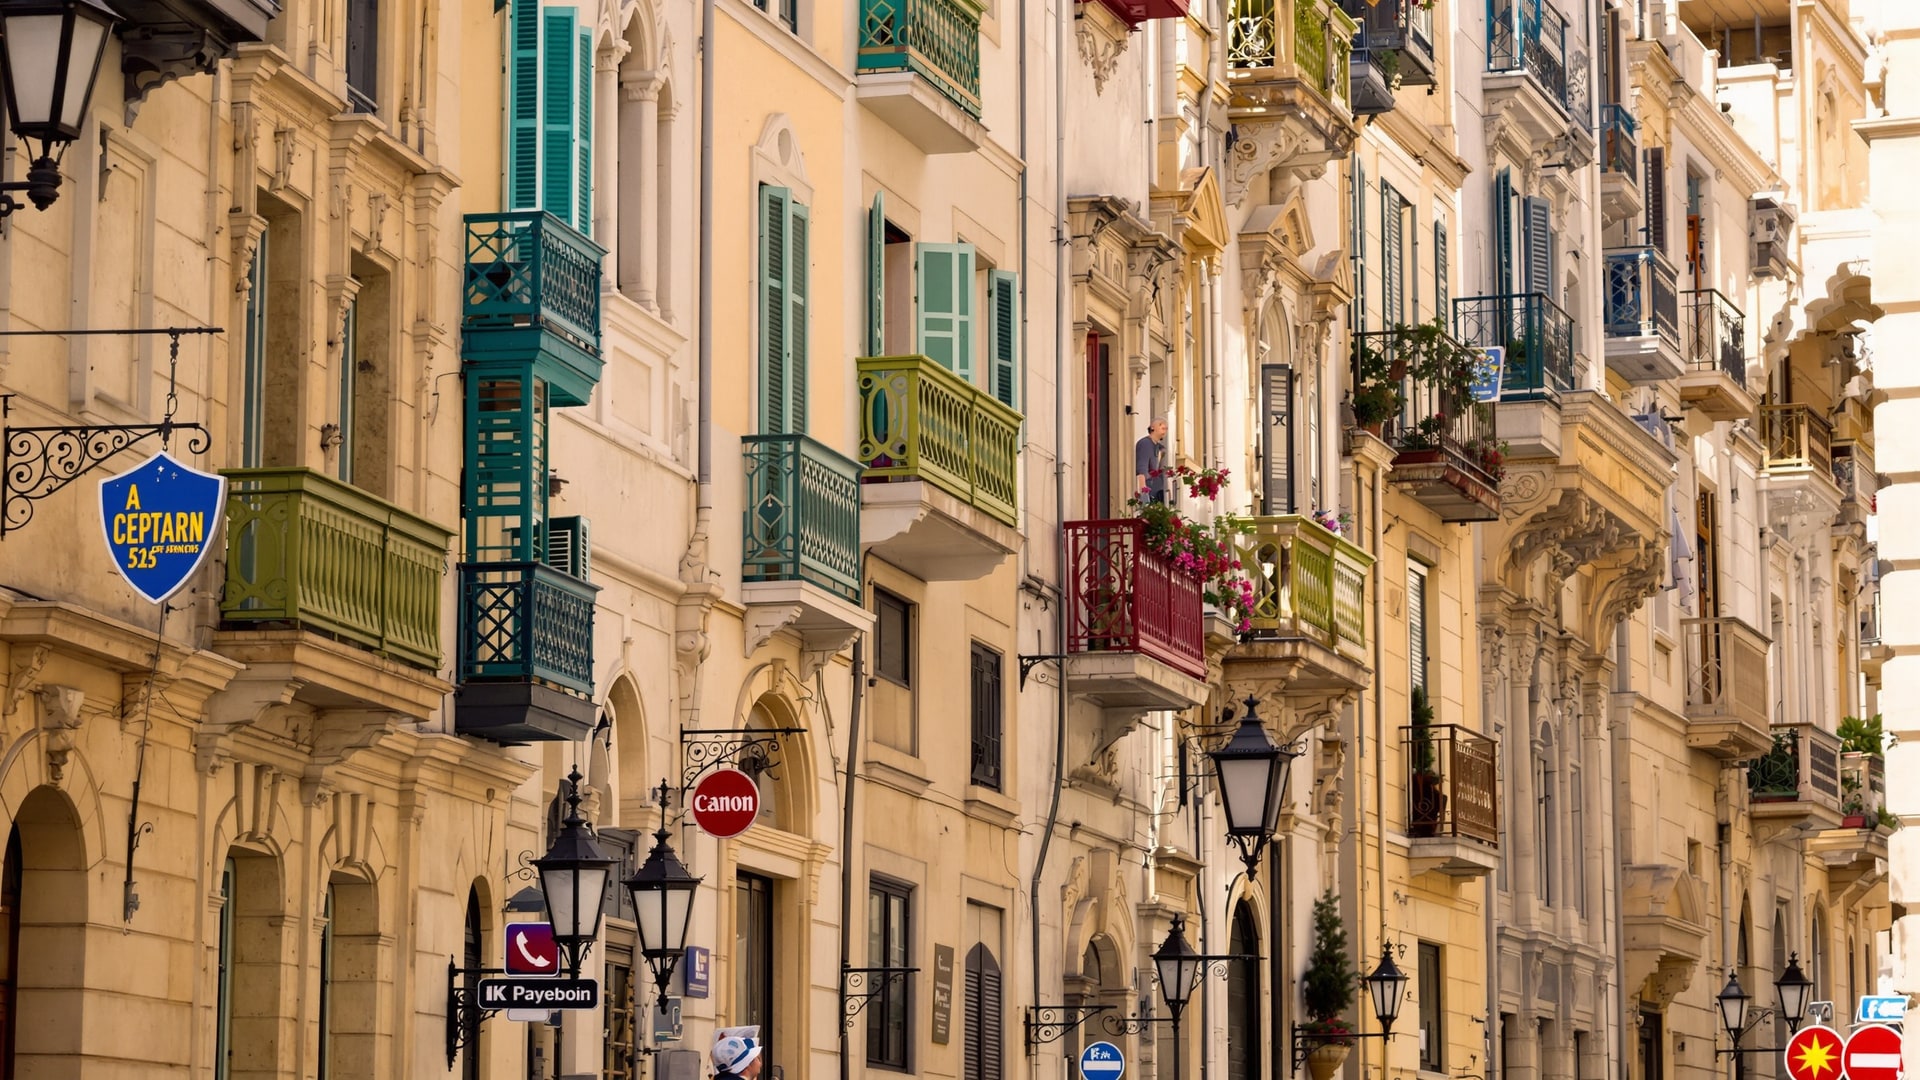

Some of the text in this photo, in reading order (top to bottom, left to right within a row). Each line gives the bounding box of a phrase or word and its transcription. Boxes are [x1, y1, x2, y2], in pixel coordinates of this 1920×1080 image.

[125, 484, 141, 510] A
[113, 511, 203, 545] CEPTARN
[694, 794, 754, 812] Canon
[486, 985, 591, 1004] IK Payeboin
